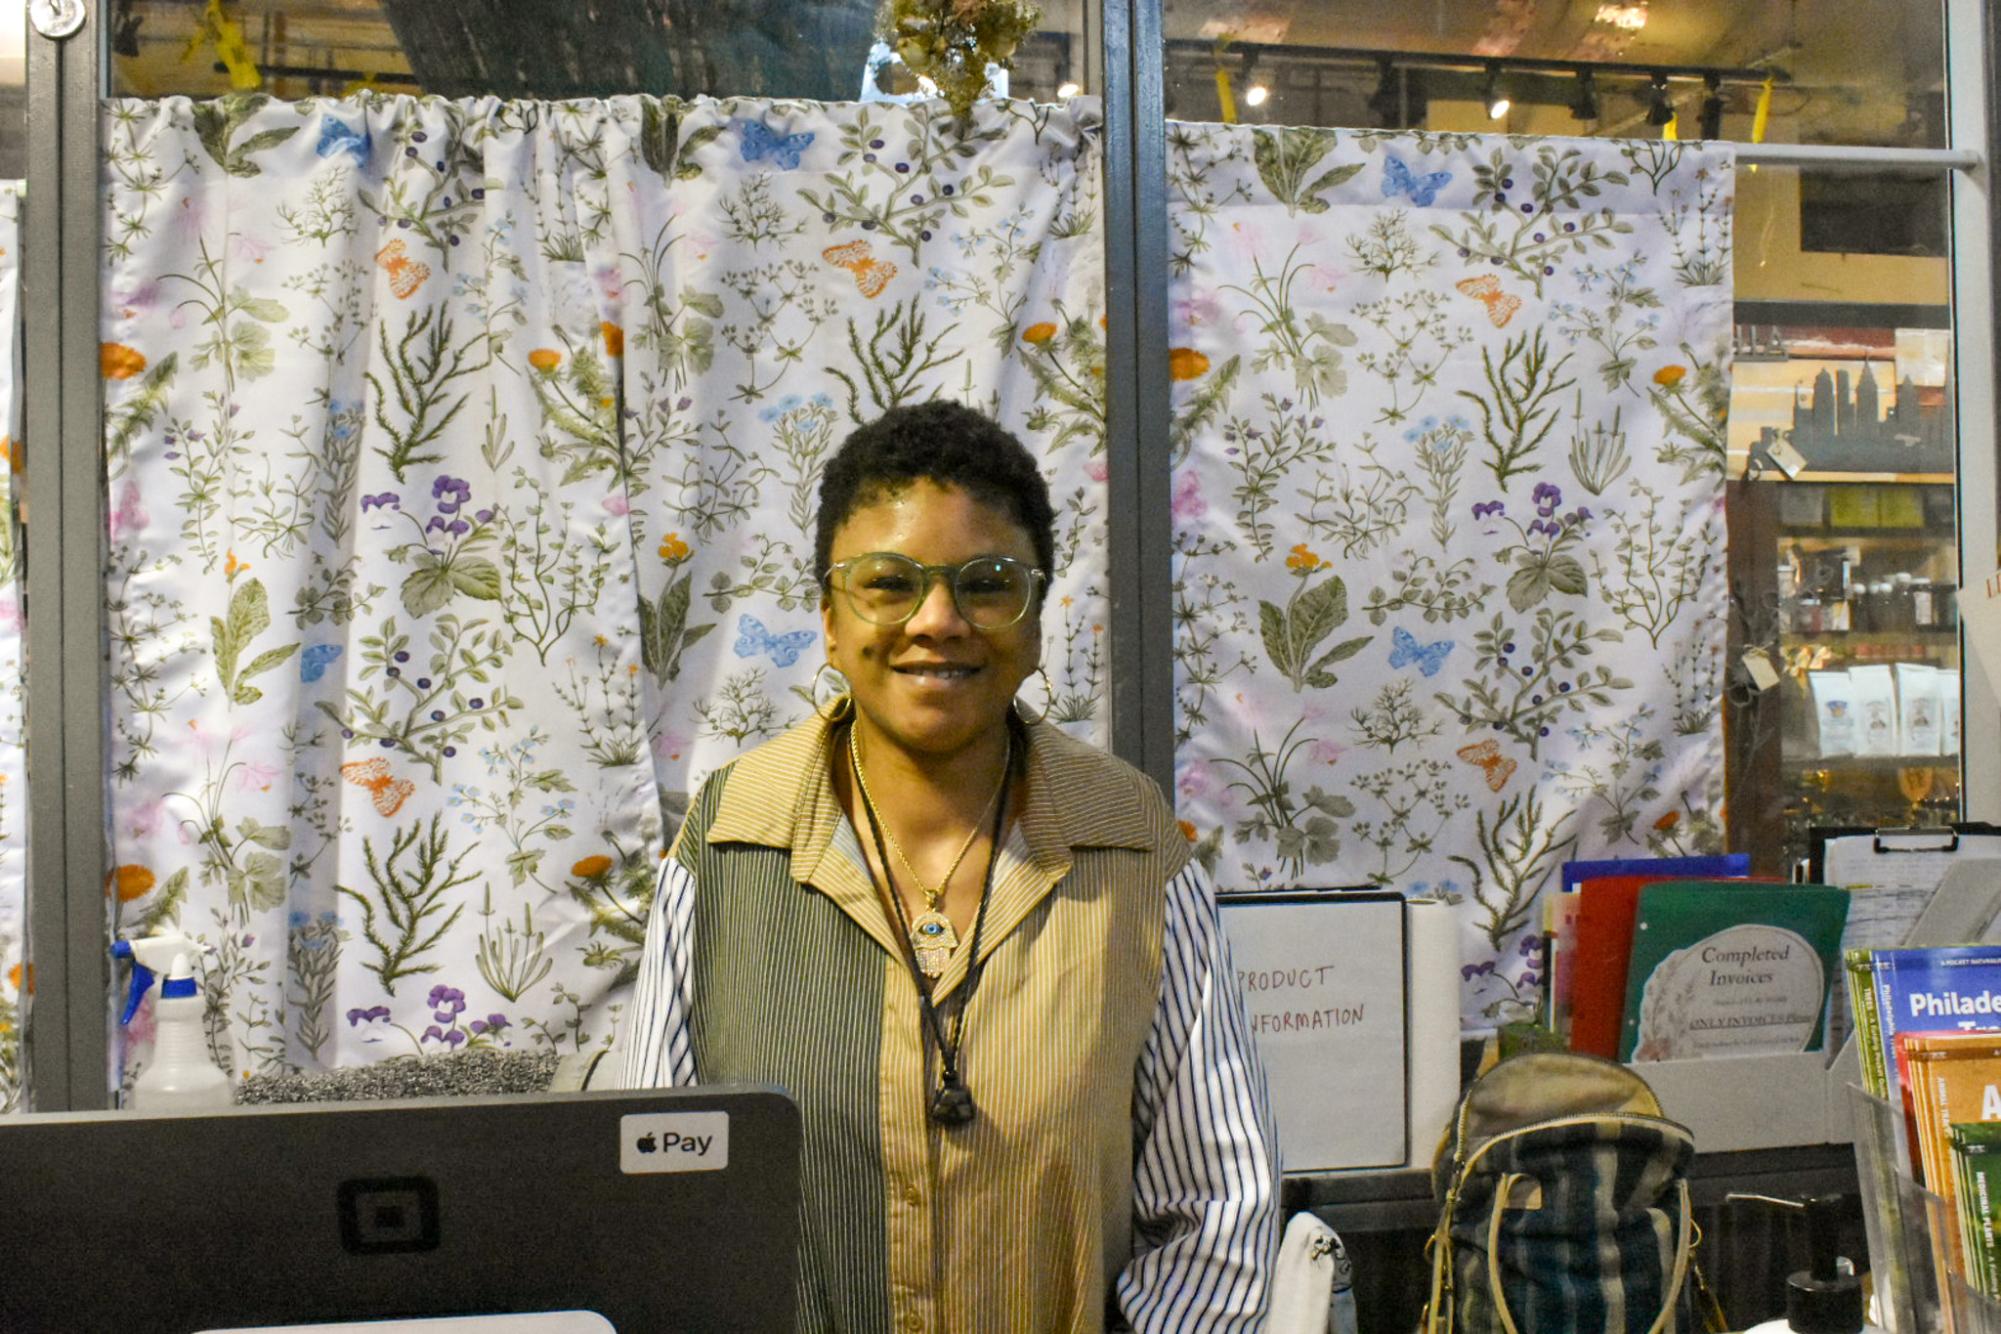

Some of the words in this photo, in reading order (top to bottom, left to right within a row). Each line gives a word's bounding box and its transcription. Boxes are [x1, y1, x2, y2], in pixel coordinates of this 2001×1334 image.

[1702, 945, 1790, 967] Completed
[1237, 965, 1335, 991] PRODUCT
[1710, 970, 1773, 986] Invoices
[1251, 1003, 1365, 1034] NFORMATION
[663, 1131, 713, 1157] Pay
[1976, 1171, 1990, 1216] MEDICINAL
[1983, 1217, 1995, 1248] PLANTS
